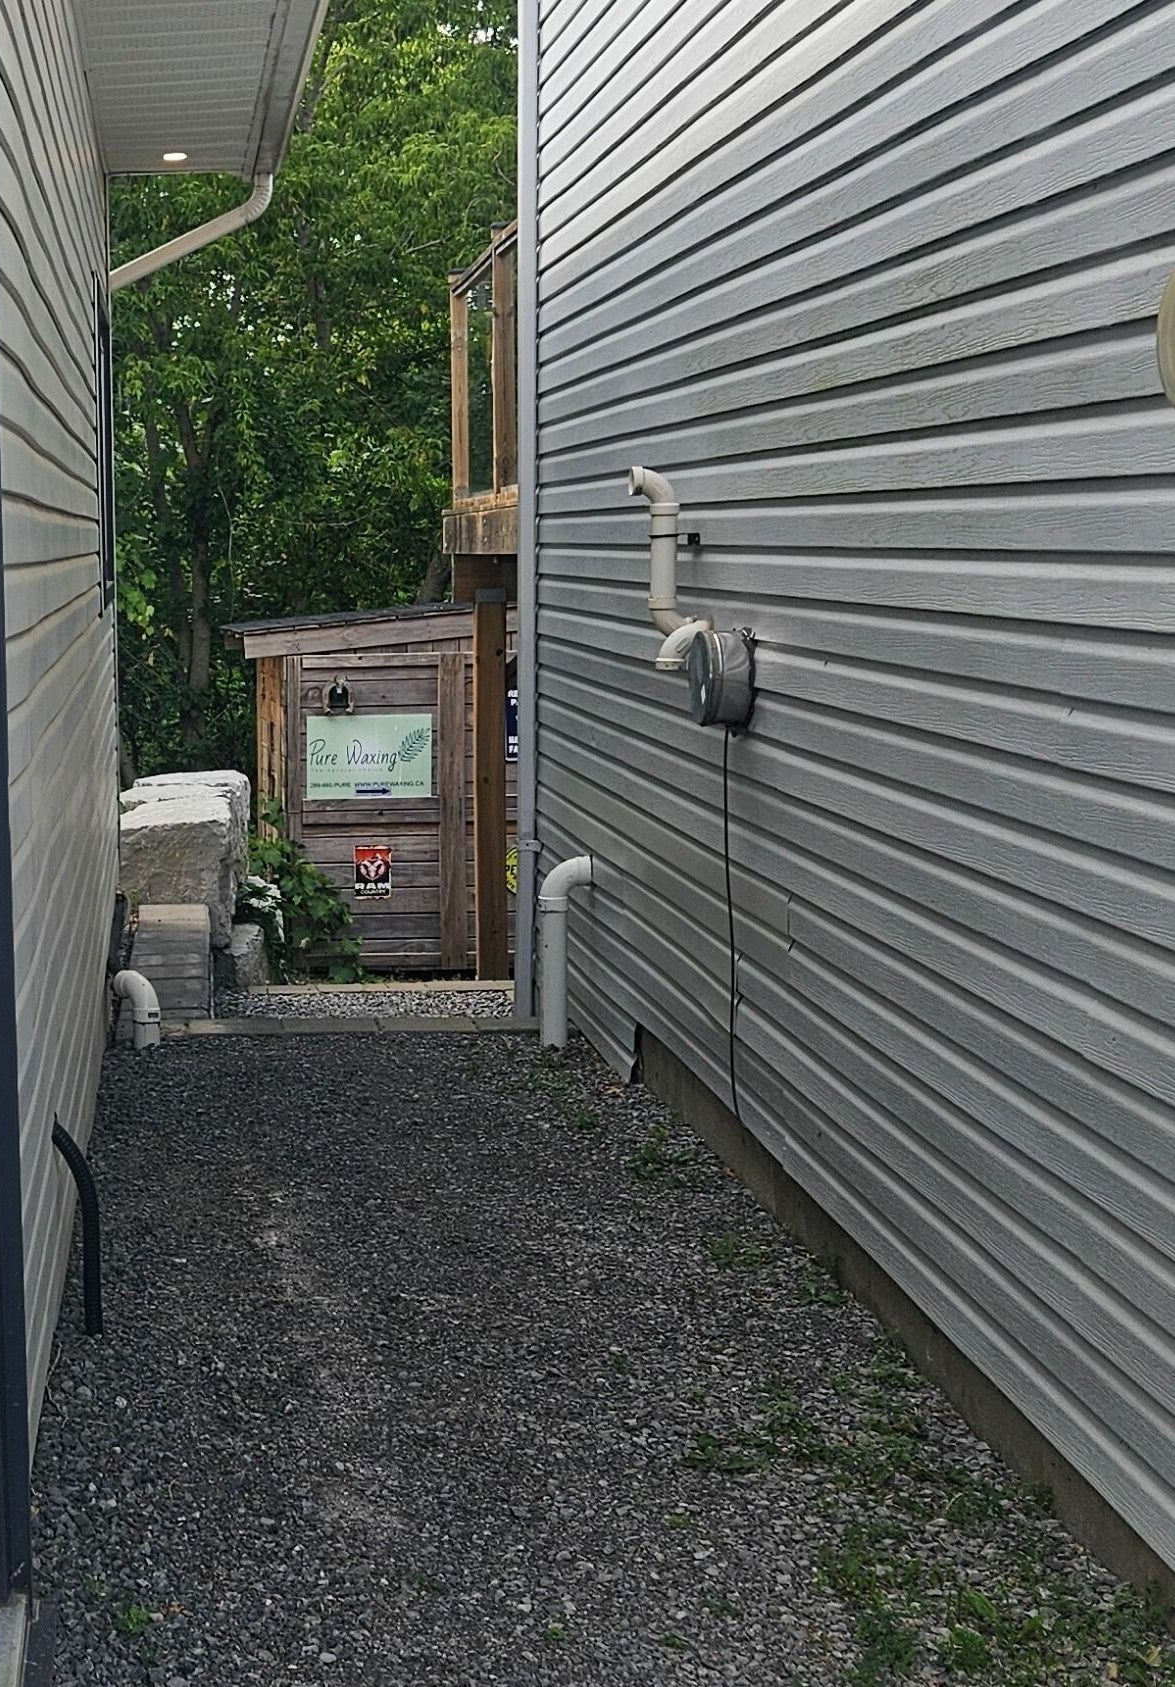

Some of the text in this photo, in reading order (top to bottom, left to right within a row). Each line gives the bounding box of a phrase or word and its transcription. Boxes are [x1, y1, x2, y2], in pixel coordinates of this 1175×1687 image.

[309, 738, 398, 773] Pure Waxing
[354, 882, 390, 890] RAM
